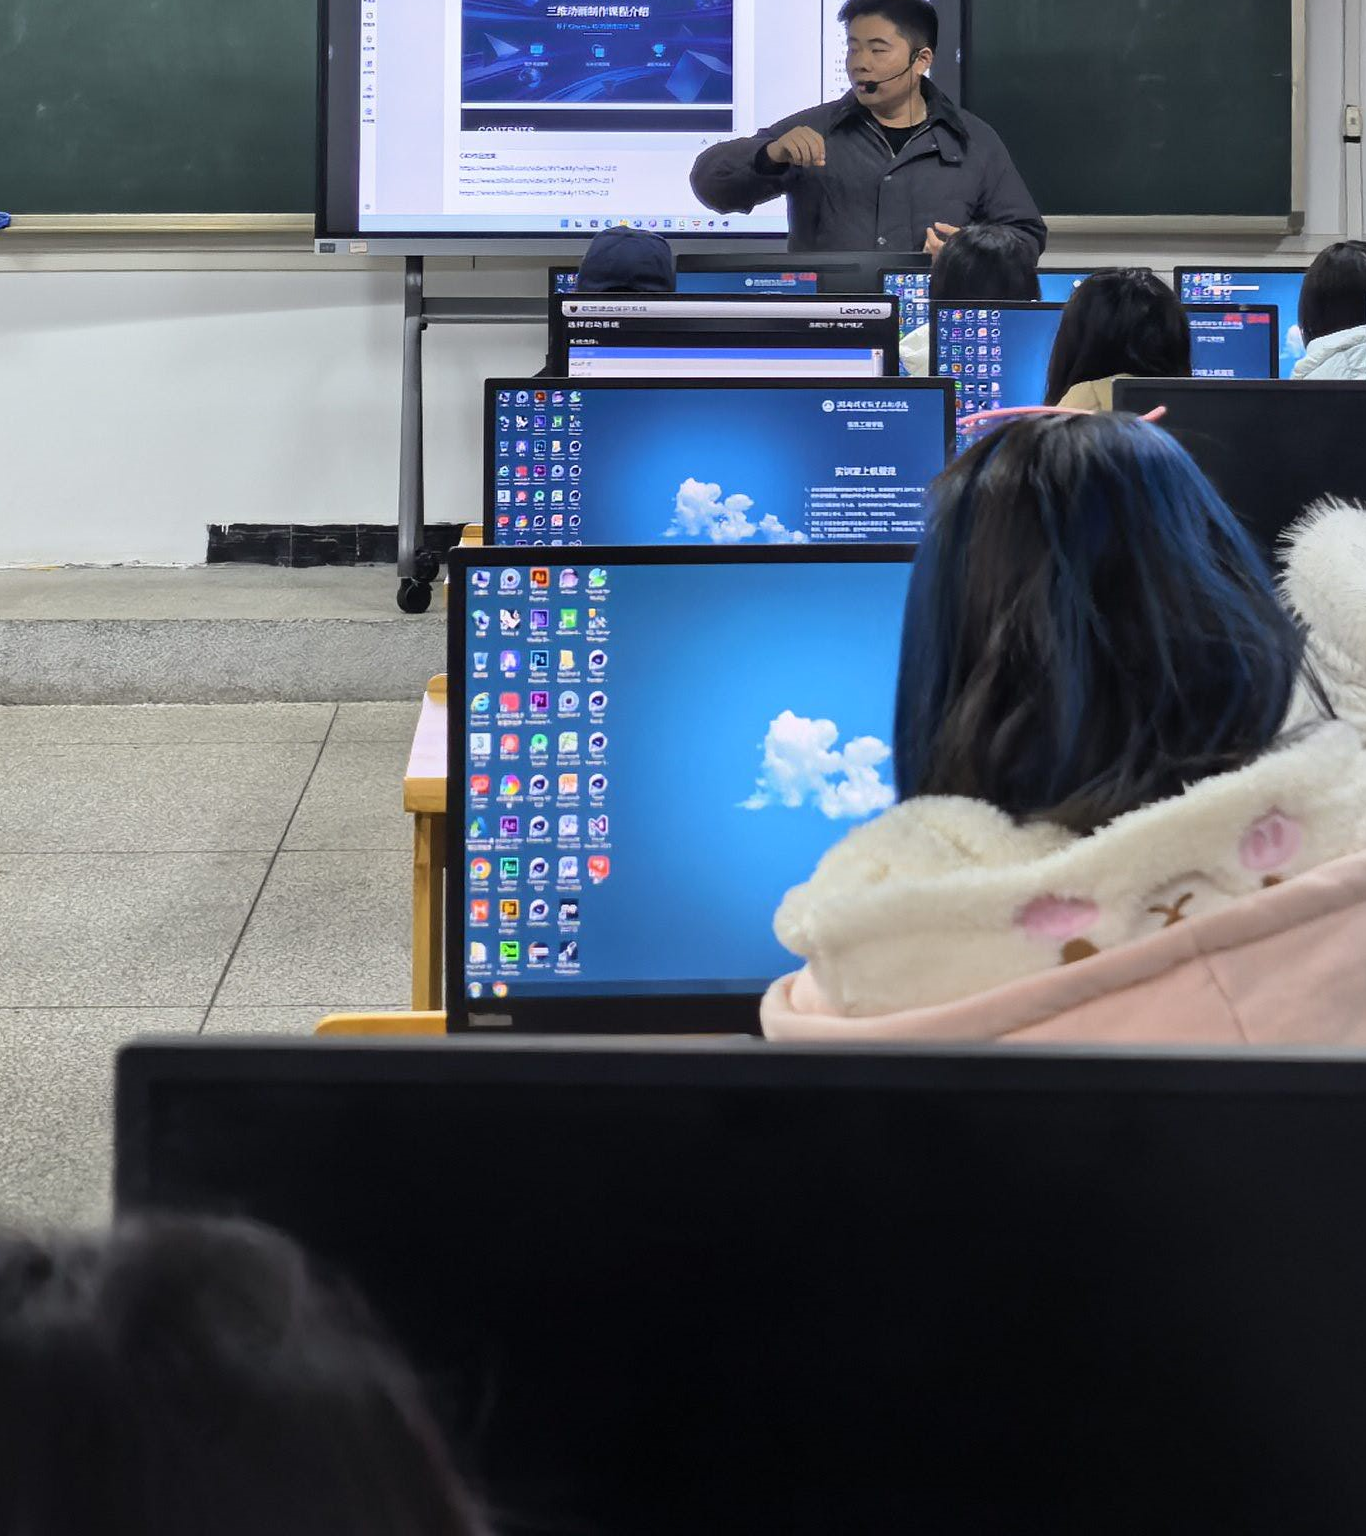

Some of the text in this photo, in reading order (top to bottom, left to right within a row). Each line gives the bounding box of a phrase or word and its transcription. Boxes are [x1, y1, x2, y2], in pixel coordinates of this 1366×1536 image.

[546, 5, 650, 18] 三维动画制作课程介绍
[839, 307, 881, 315] Lenovo
[567, 321, 620, 329] 选择启动系统
